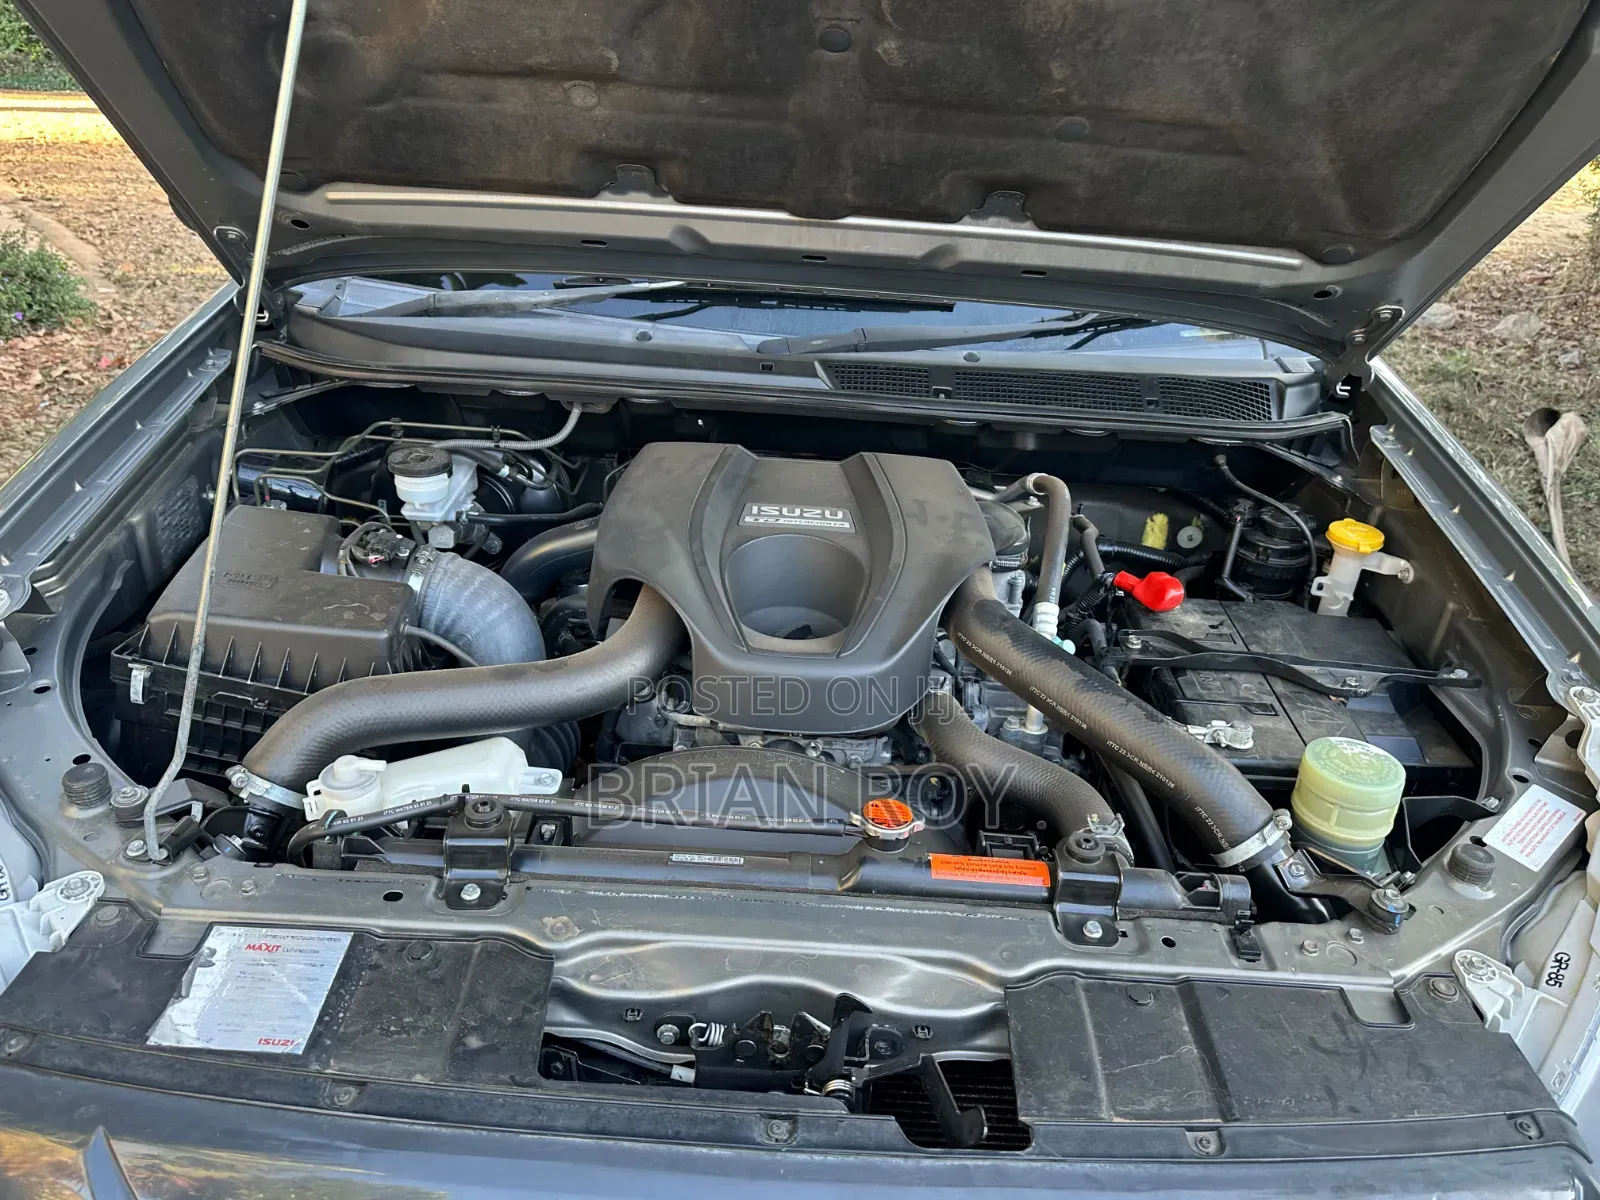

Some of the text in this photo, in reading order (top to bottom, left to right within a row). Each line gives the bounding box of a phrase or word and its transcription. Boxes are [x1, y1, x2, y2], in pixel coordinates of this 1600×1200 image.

[752, 505, 844, 519] ISUZU
[245, 942, 282, 953] MAXIT
[1545, 952, 1571, 988] GR-85
